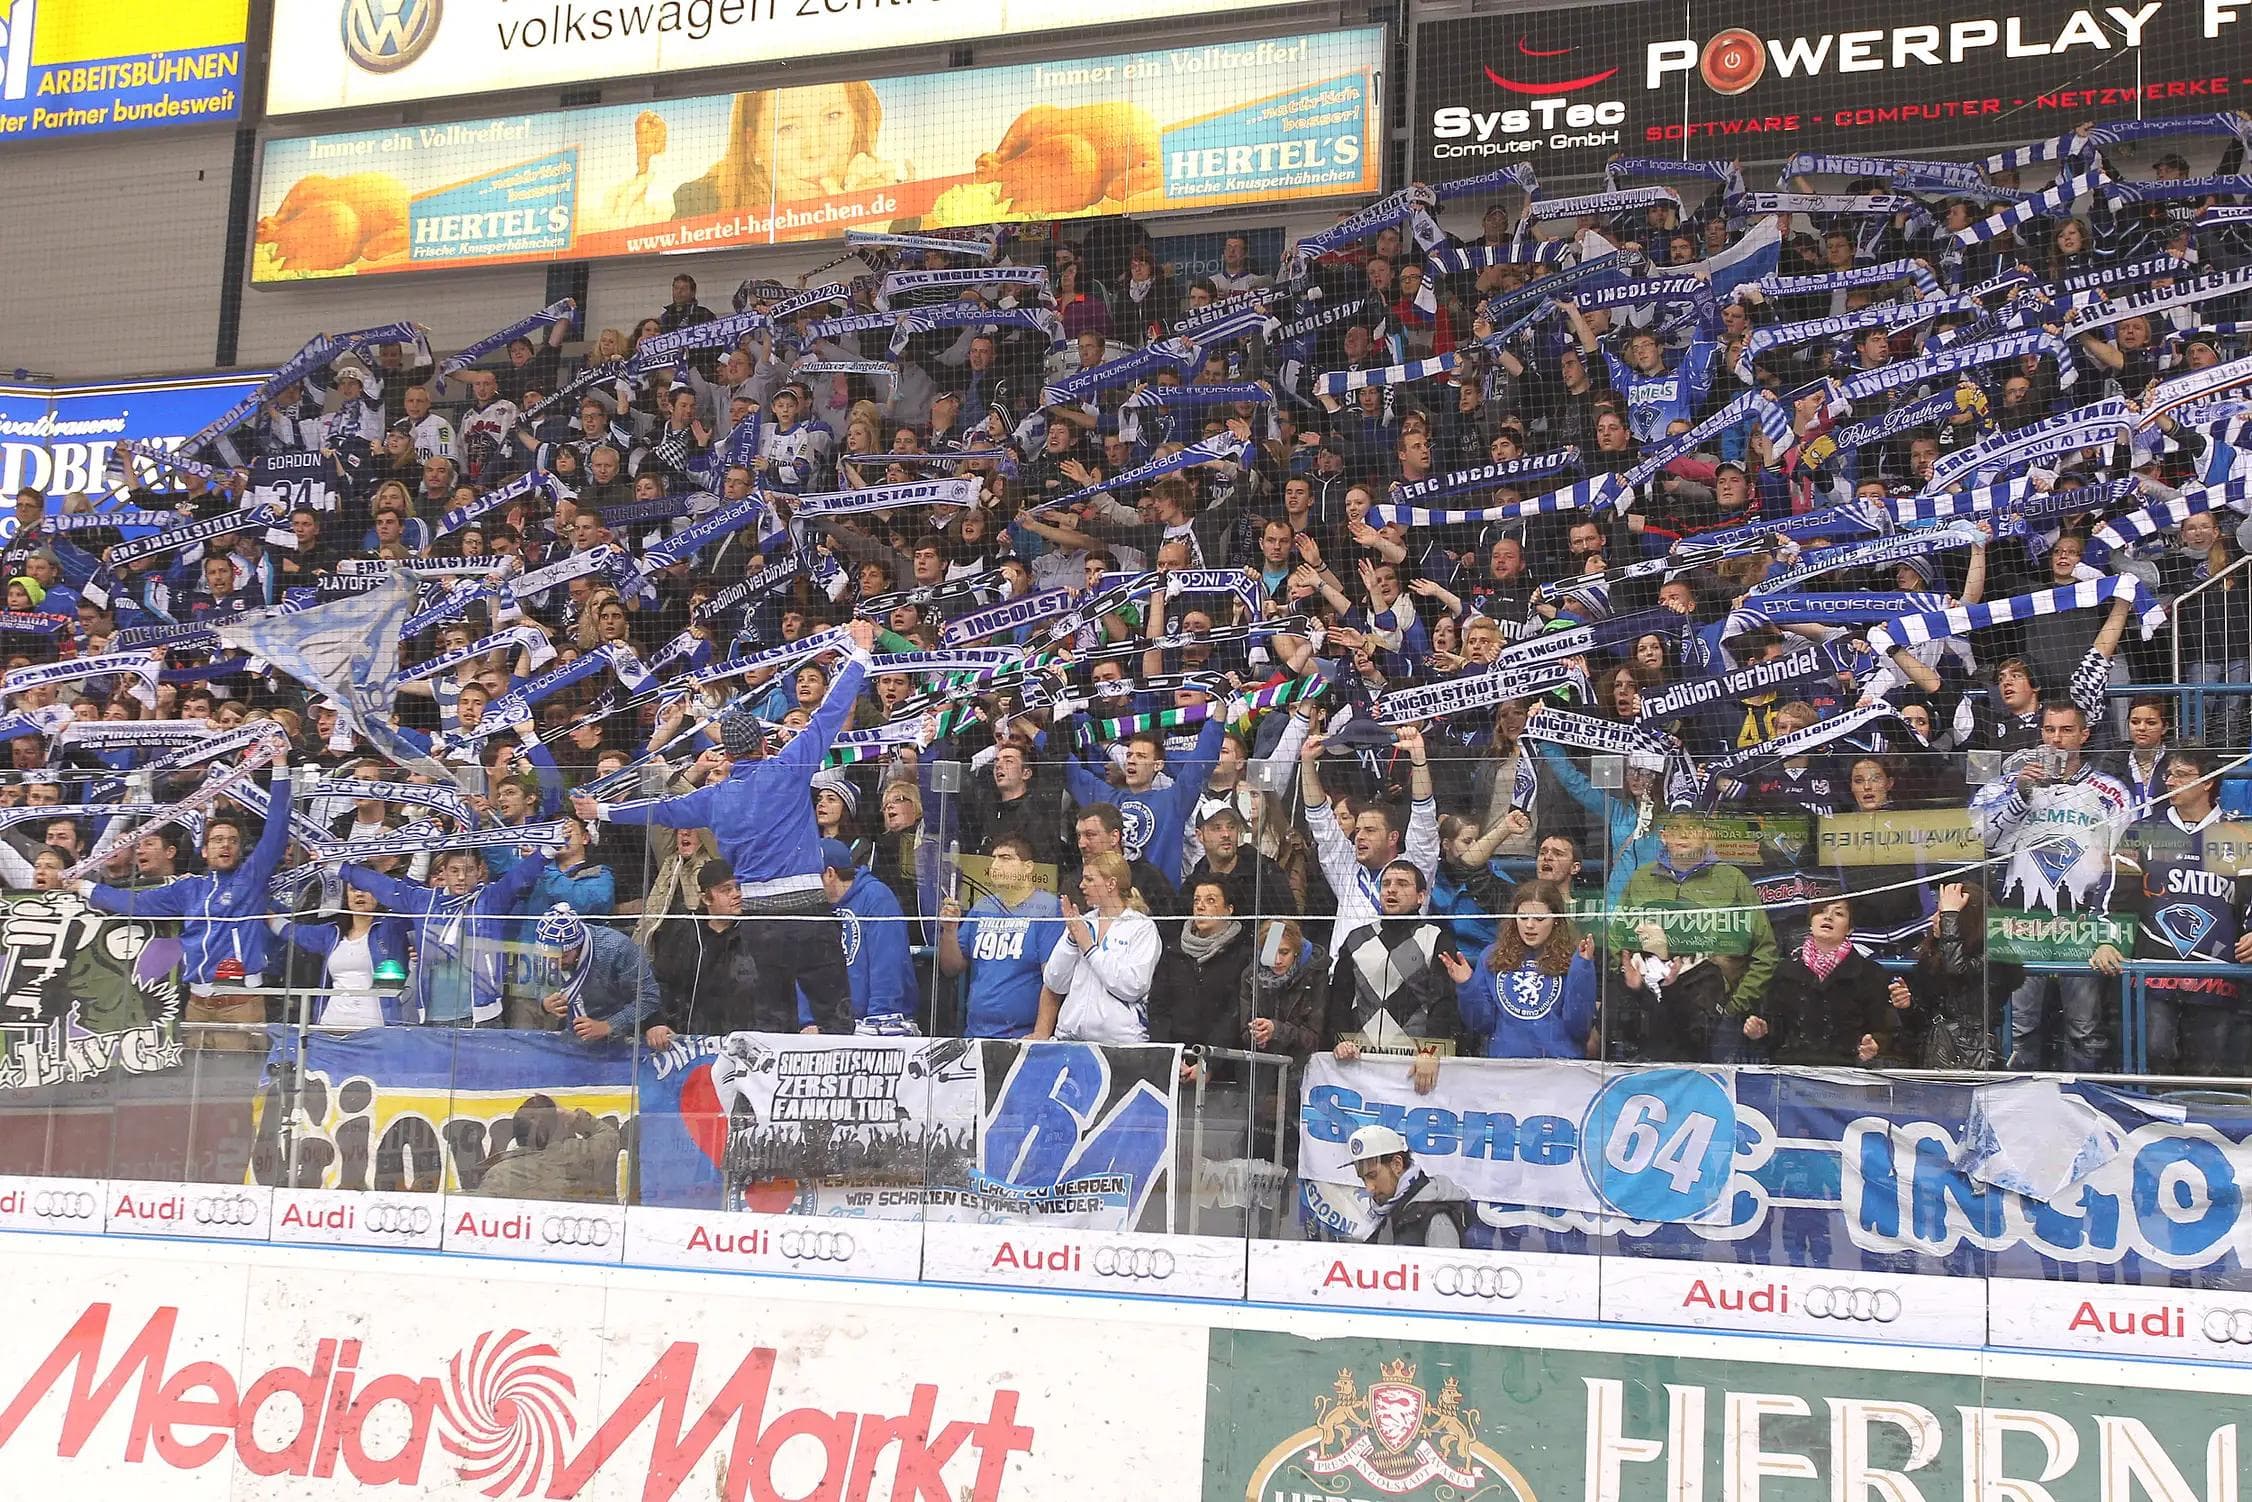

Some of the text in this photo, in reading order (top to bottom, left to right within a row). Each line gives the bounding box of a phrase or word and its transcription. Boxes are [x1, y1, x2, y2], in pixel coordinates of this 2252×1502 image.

[36, 51, 240, 97] ARBEITSBÜHNEN
[1035, 38, 1308, 88] Immer ein Volltreffer!
[33, 106, 108, 130] Partner
[113, 89, 235, 122] bundesweit
[1433, 98, 1626, 142] SysTec
[1646, 77, 2230, 142] SOFTWARE COMPUTER NETZWERKE
[310, 119, 532, 159] Immer ein Volltreffer!
[1433, 130, 1619, 159] Computer GmbH
[1170, 169, 1355, 195] Frische Knusperhähnchen
[1442, 171, 1499, 191] Ingolstadt
[2136, 178, 2180, 191] Saison
[627, 193, 897, 253] www.hertel-haehnchen.de
[1316, 227, 1346, 246] ERC
[413, 237, 565, 258] Frische Knusperhähnchen
[1776, 299, 1956, 344] INGOLSTADT
[2072, 301, 2117, 328] ERC
[640, 313, 766, 358] NGOLSTADT
[1850, 334, 2039, 399] INGOLSTADT
[1068, 373, 1092, 392] ERC
[1838, 400, 1953, 448] Blue Panthers
[268, 453, 322, 471] GORDON
[1405, 452, 1572, 500] ERC INGOLSTADT
[1936, 444, 1978, 477] ERC
[272, 479, 312, 512] 34
[824, 485, 940, 510] INGOLSTADT
[112, 514, 243, 562] ERC INGOLSTADT
[663, 502, 753, 552] ERC Ingolstadt
[1714, 511, 1837, 546] ERC Ingolstadt
[318, 576, 388, 591] PLAYOFFS
[356, 561, 389, 576] ERC
[700, 554, 799, 618] Tradition verbindet
[1763, 597, 1906, 614] ERC Ingolstadt
[121, 627, 151, 645] DIE
[43, 654, 150, 679] INGOLSTADT
[872, 649, 1014, 668] INGOLSTADT
[1499, 650, 1527, 670] ERC
[1727, 646, 1820, 694] verbindet
[497, 653, 594, 710] ERC Ingolstadt
[1390, 668, 1568, 713] INGOLSTADT 09/10
[1529, 715, 1634, 743] INGOLSTAD
[1804, 715, 1851, 738] Leben
[1853, 703, 1887, 720] lang
[142, 738, 162, 748] UND
[198, 734, 236, 752] Leben
[973, 931, 1026, 961] 1964
[779, 1051, 904, 1075] SICHERHEITSWAHN
[775, 1071, 899, 1098] ZERSTÖRT
[771, 1099, 897, 1122] FANKULTUR
[1303, 1085, 1577, 1166] Szene
[1604, 1094, 1718, 1195] 64
[1054, 1177, 1127, 1197] WERDEN,
[114, 1194, 185, 1221] Audi
[281, 1203, 354, 1230] Audi
[846, 1192, 873, 1206] WIR
[961, 1194, 979, 1209] ES
[981, 1196, 1031, 1215] IMMER
[1036, 1197, 1105, 1214] WIEDER:
[454, 1211, 532, 1240] Audi
[687, 1225, 769, 1255] Audi
[992, 1241, 1082, 1272] Audi
[1323, 1260, 1420, 1292] Audi
[1682, 1279, 1789, 1314] Audi
[2069, 1301, 2187, 1338] Audi
[0, 1303, 1034, 1502] Media Markt
[1317, 1438, 1369, 1471] PREMIUM
[1423, 1446, 1470, 1486] BAVARIA
[1355, 1458, 1431, 1491] INGOLSTADT
